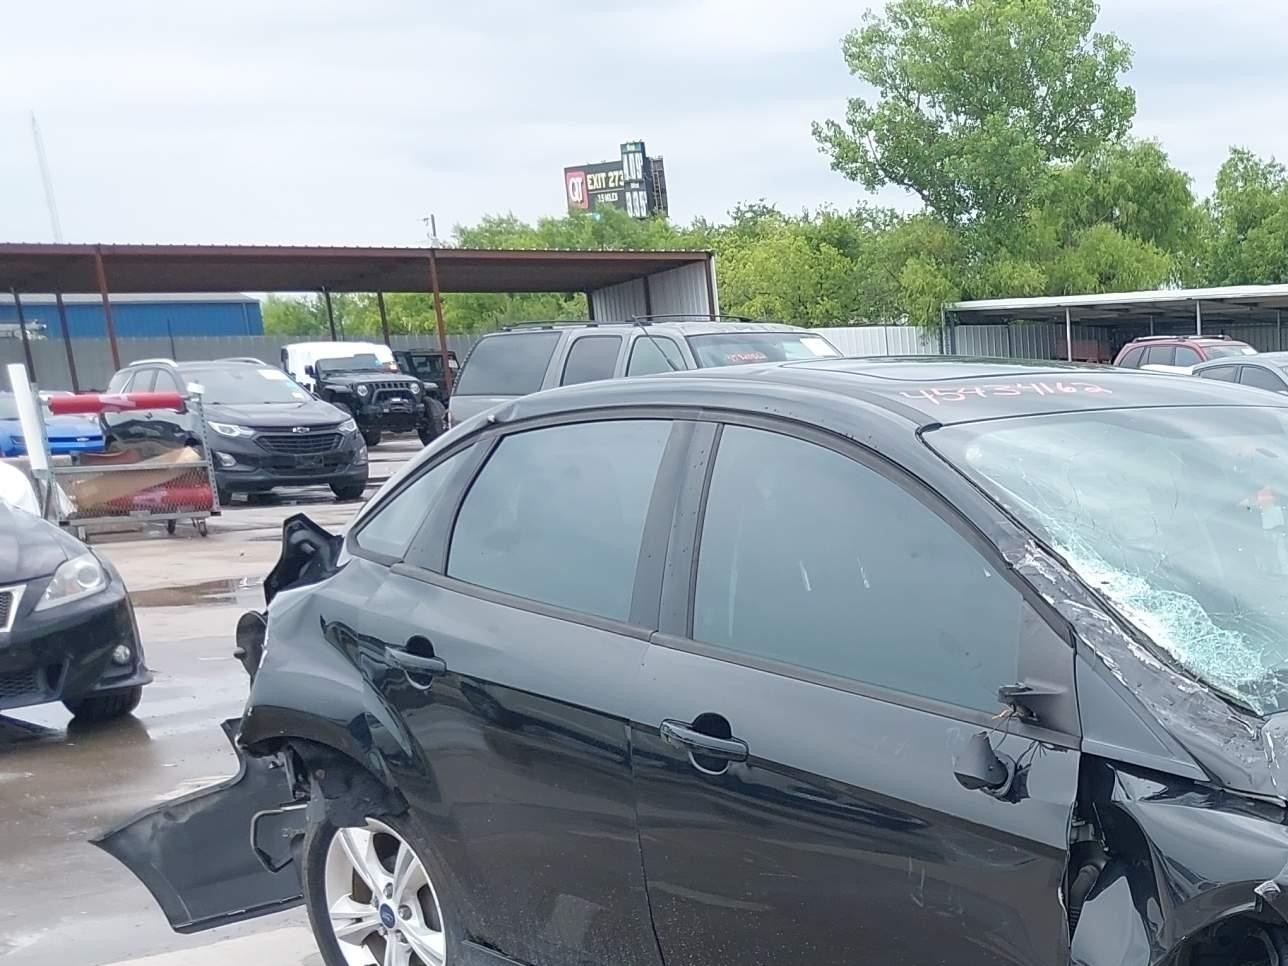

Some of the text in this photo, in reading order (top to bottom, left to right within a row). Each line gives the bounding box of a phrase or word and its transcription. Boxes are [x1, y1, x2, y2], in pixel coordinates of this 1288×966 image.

[587, 170, 625, 190] EXIT 273
[899, 381, 1114, 406] 45434162
